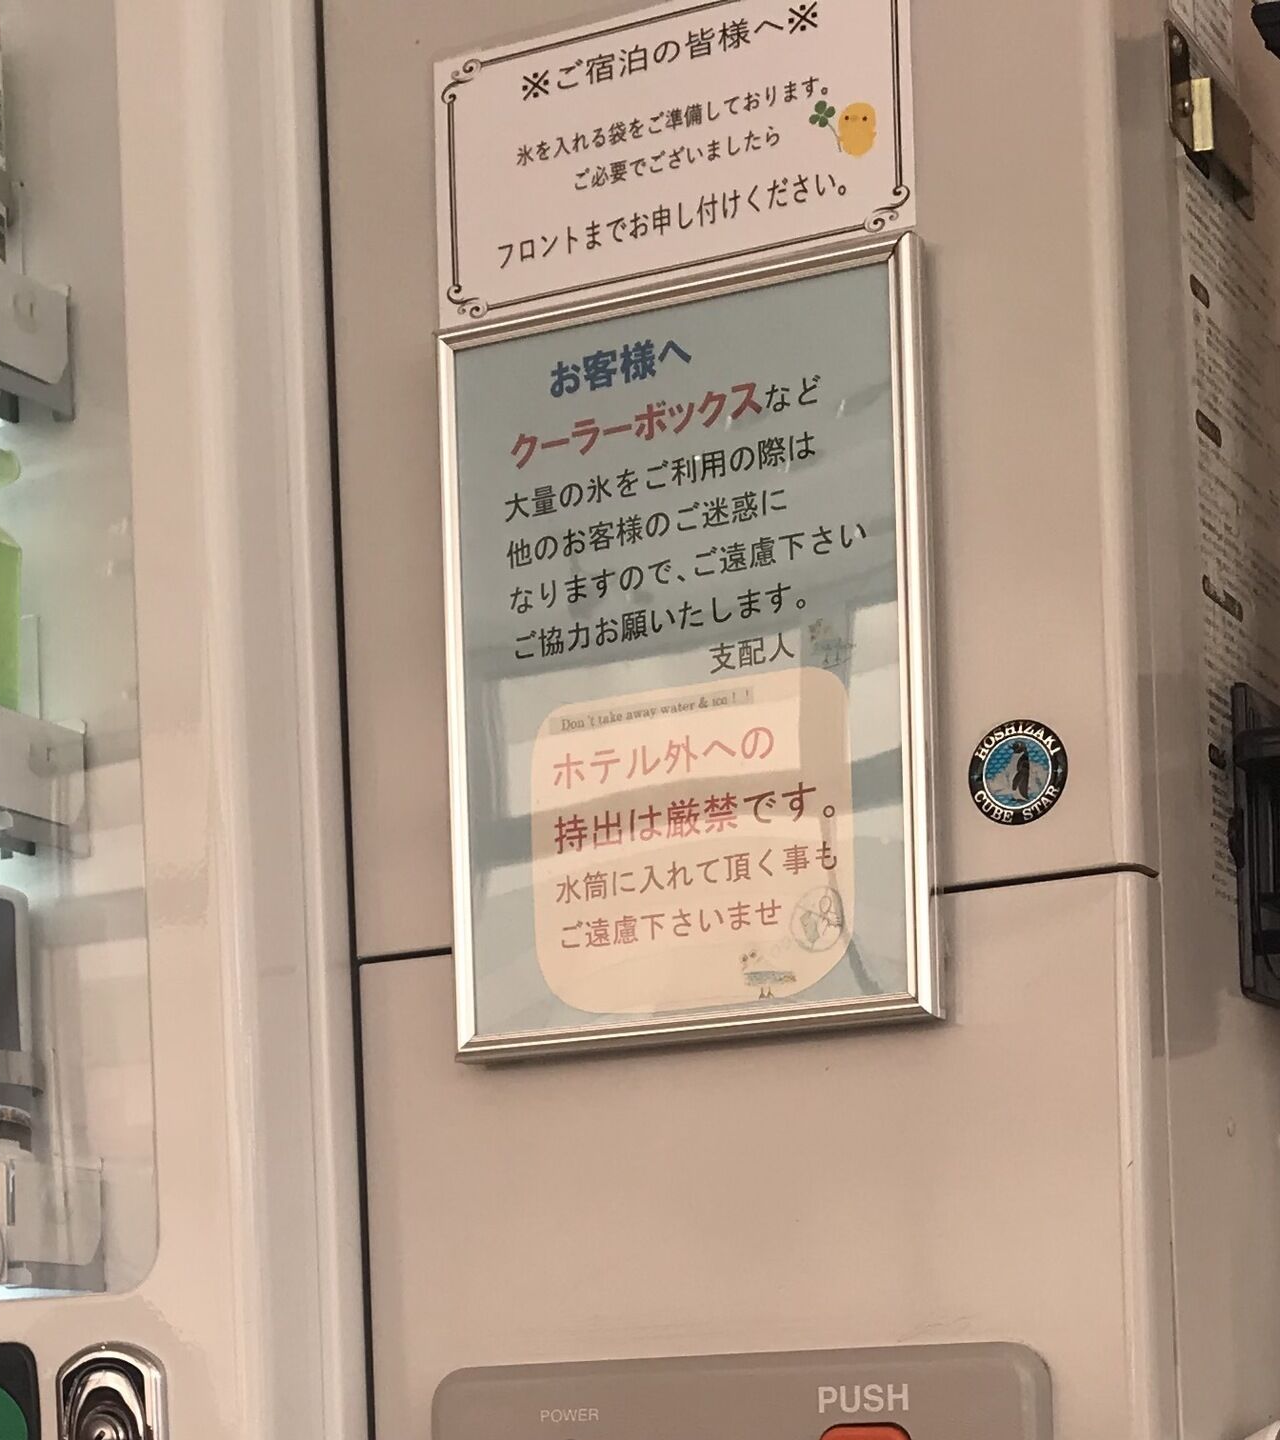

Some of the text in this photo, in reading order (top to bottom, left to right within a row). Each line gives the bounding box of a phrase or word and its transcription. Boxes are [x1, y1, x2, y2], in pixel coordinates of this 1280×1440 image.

[522, 2, 818, 101] ※ご宿泊の皆様へ※
[517, 76, 829, 167] 氷を入れる袋をご準備しております。
[575, 126, 781, 191] ご必要でございましたら
[498, 172, 847, 270] フロントまでお申し付けください。
[550, 339, 692, 397] お客様へ
[510, 375, 821, 469] クーラーボックスなど
[505, 431, 817, 523] 大量の氷をご利用の際は
[506, 488, 788, 570] 他のお客様のご迷惑に
[509, 522, 867, 614] なりますので、ご遠慮下さい
[513, 583, 807, 660] ご協力お願いたします。
[710, 633, 795, 675] 支配人
[598, 711, 624, 726] take
[625, 707, 657, 721] away
[660, 701, 696, 715] water
[975, 721, 1062, 761] HOSHIZAKI
[552, 725, 775, 791] ホテル外への
[554, 781, 836, 856] 持出は厳禁です。
[974, 784, 1060, 823] CUBE STAR
[555, 841, 838, 905] 水筒に入れて頂く事も
[560, 898, 783, 952] ご遠慮下さいませ
[540, 1407, 600, 1424] POWER
[817, 1382, 910, 1415] PUSH
